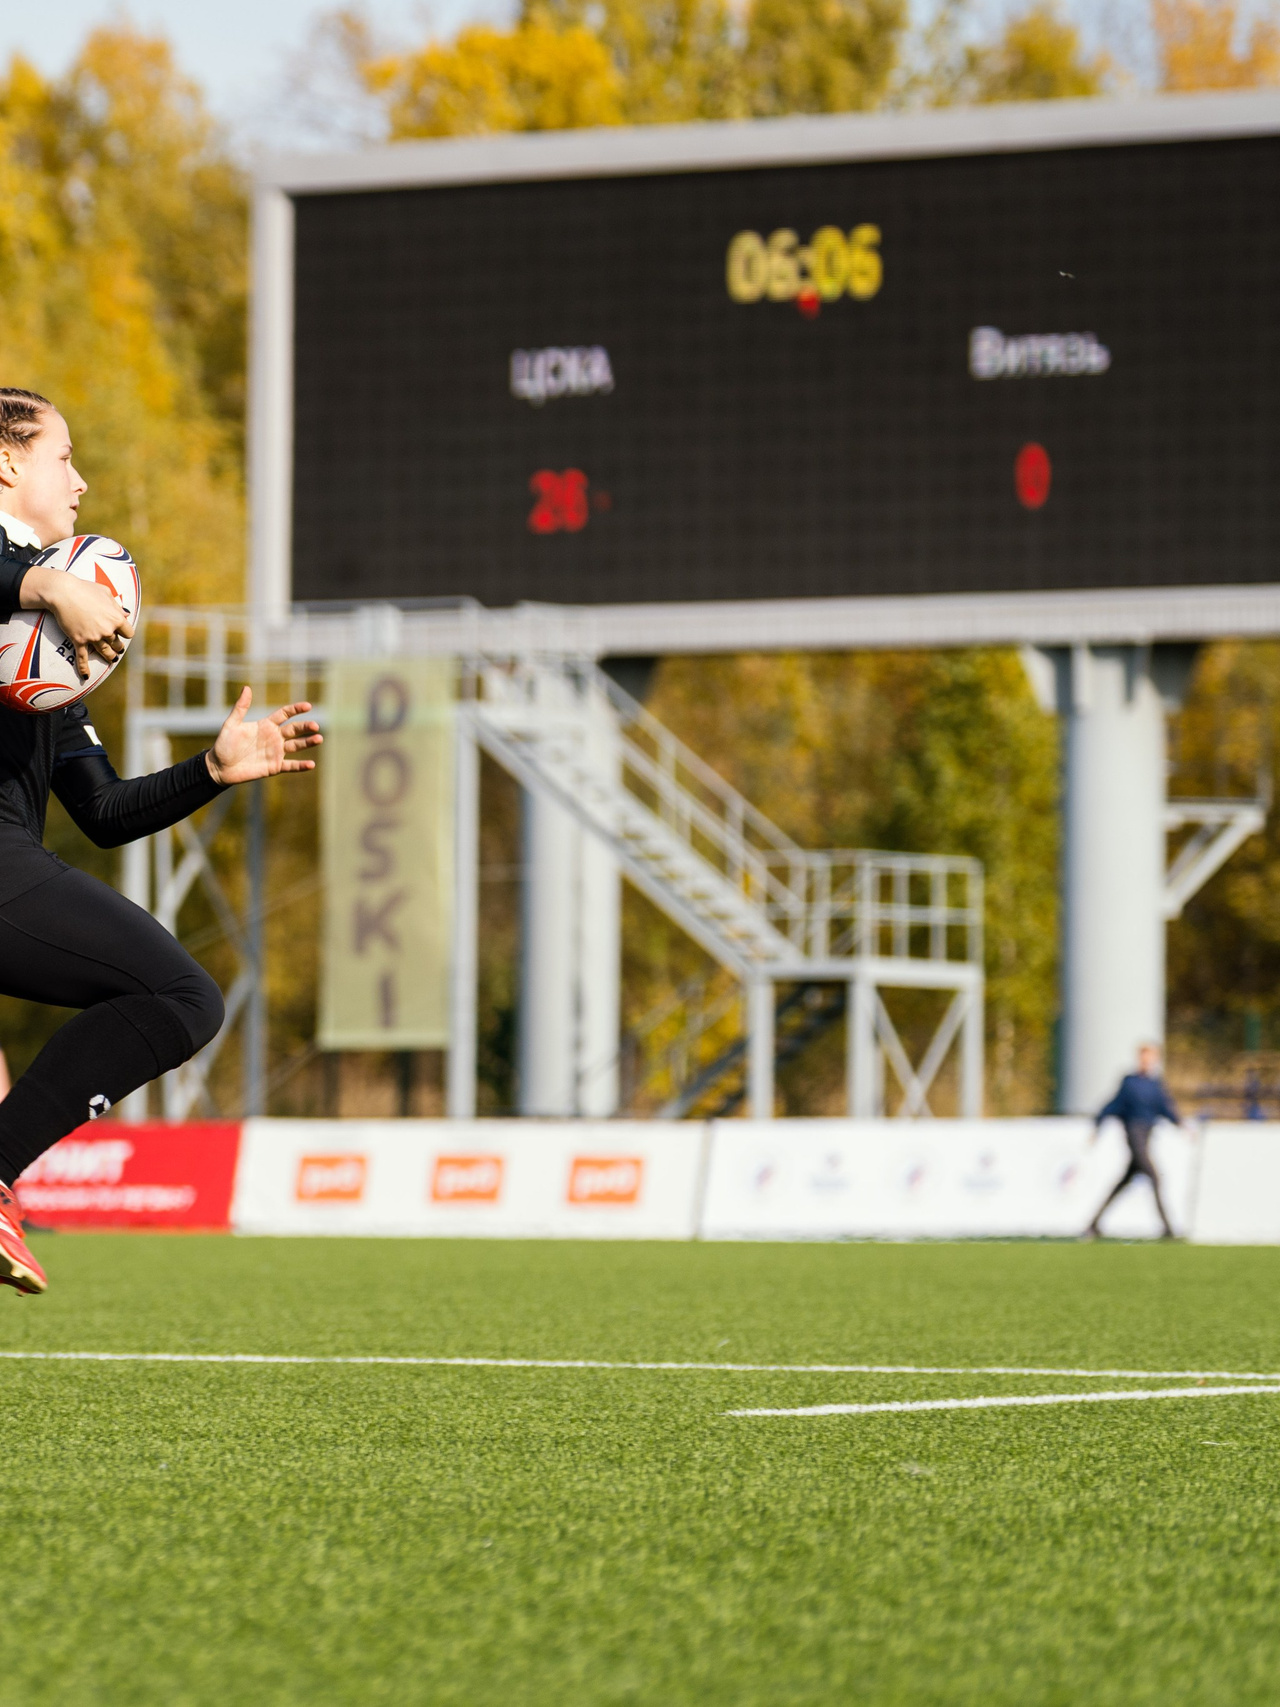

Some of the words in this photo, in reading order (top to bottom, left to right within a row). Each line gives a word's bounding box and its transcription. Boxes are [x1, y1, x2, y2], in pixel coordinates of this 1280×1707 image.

[726, 222, 883, 304] 06:06
[510, 346, 615, 408] ЦСКА
[969, 325, 1111, 381] Витязь
[1015, 441, 1051, 509] 0
[353, 674, 412, 1029] DOSKI
